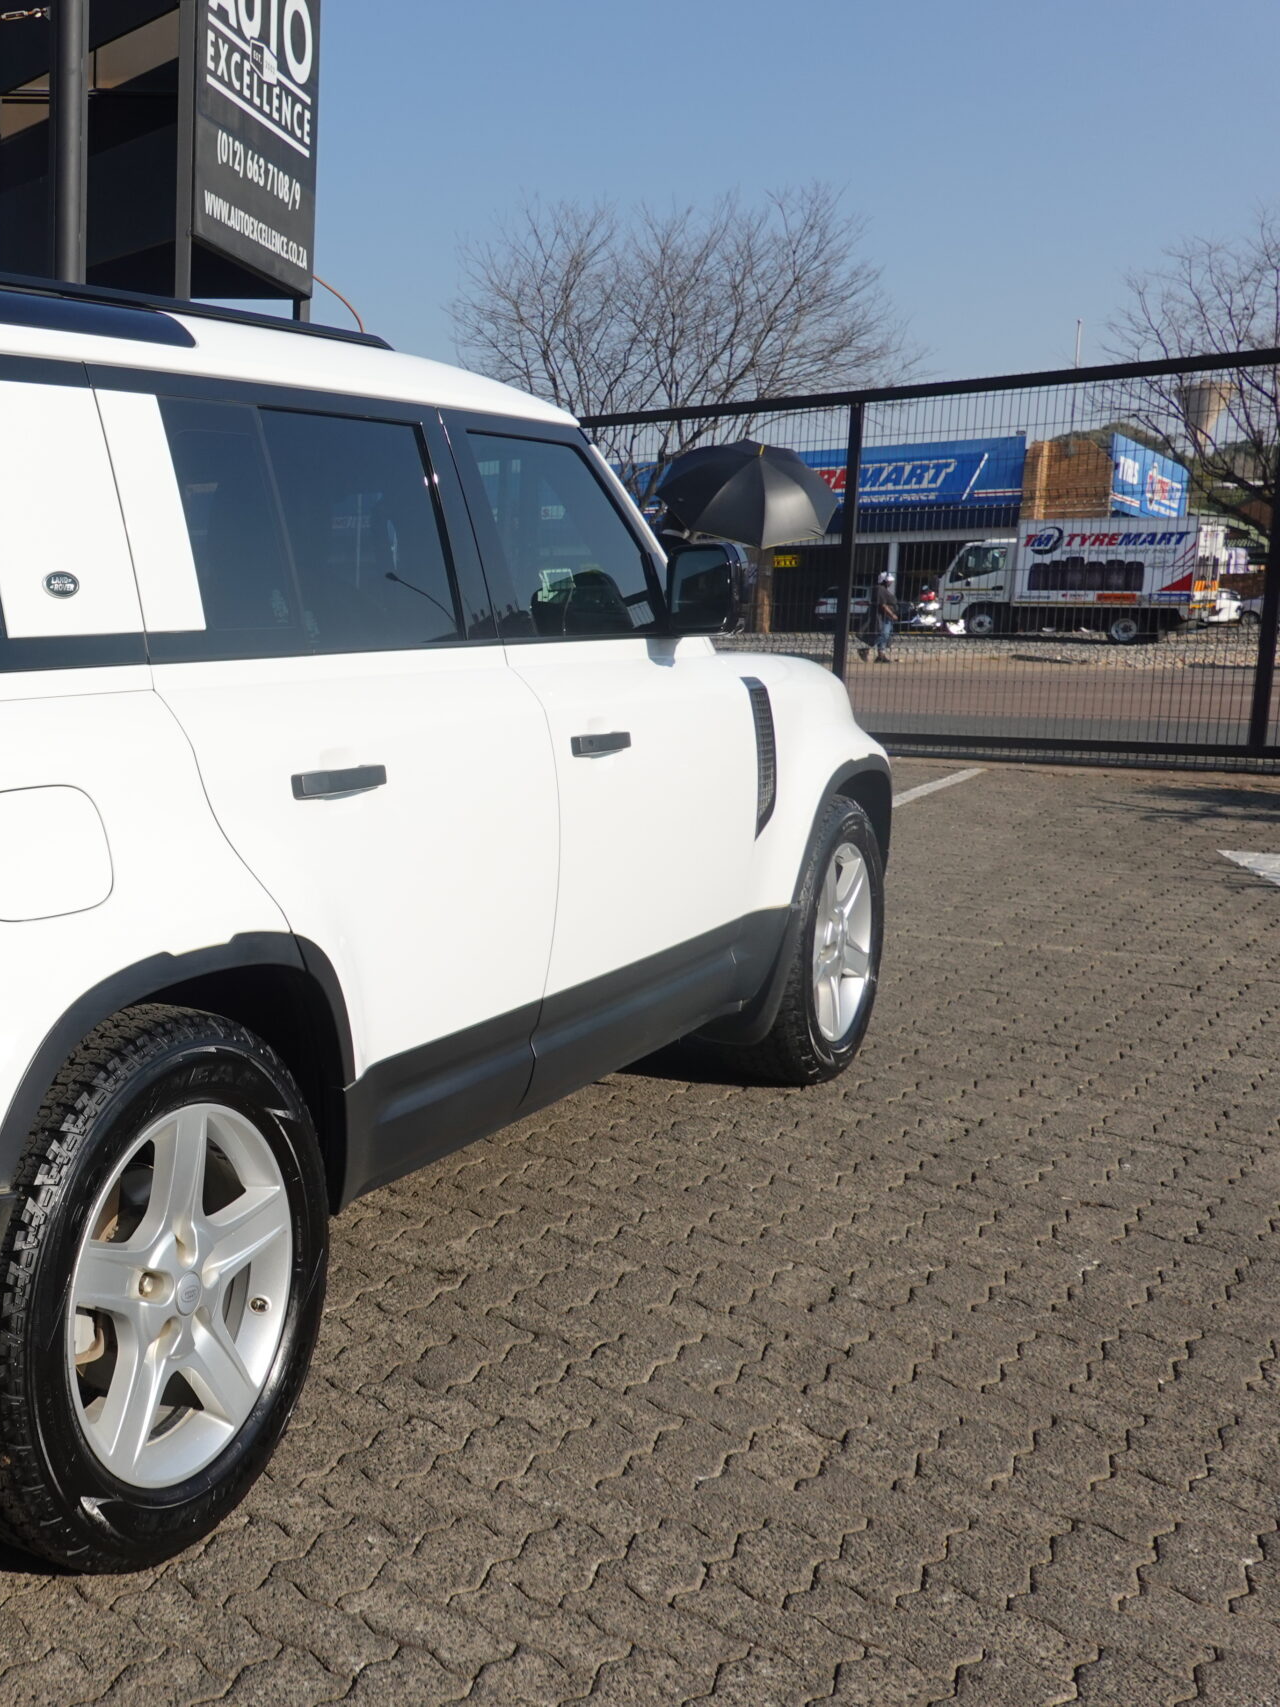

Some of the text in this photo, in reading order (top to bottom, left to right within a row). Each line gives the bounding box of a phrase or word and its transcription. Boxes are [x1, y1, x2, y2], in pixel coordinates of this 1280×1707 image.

[208, 0, 312, 84] UTO
[206, 29, 311, 146] EXCELLENCE
[217, 129, 301, 211] (012) 663 7108/9
[204, 189, 308, 270] WWW.AUTOEXCELLENCE.CO.ZA
[1065, 531, 1191, 547] TYREMART
[51, 576, 69, 584] LAND
[53, 583, 75, 591] ROVER
